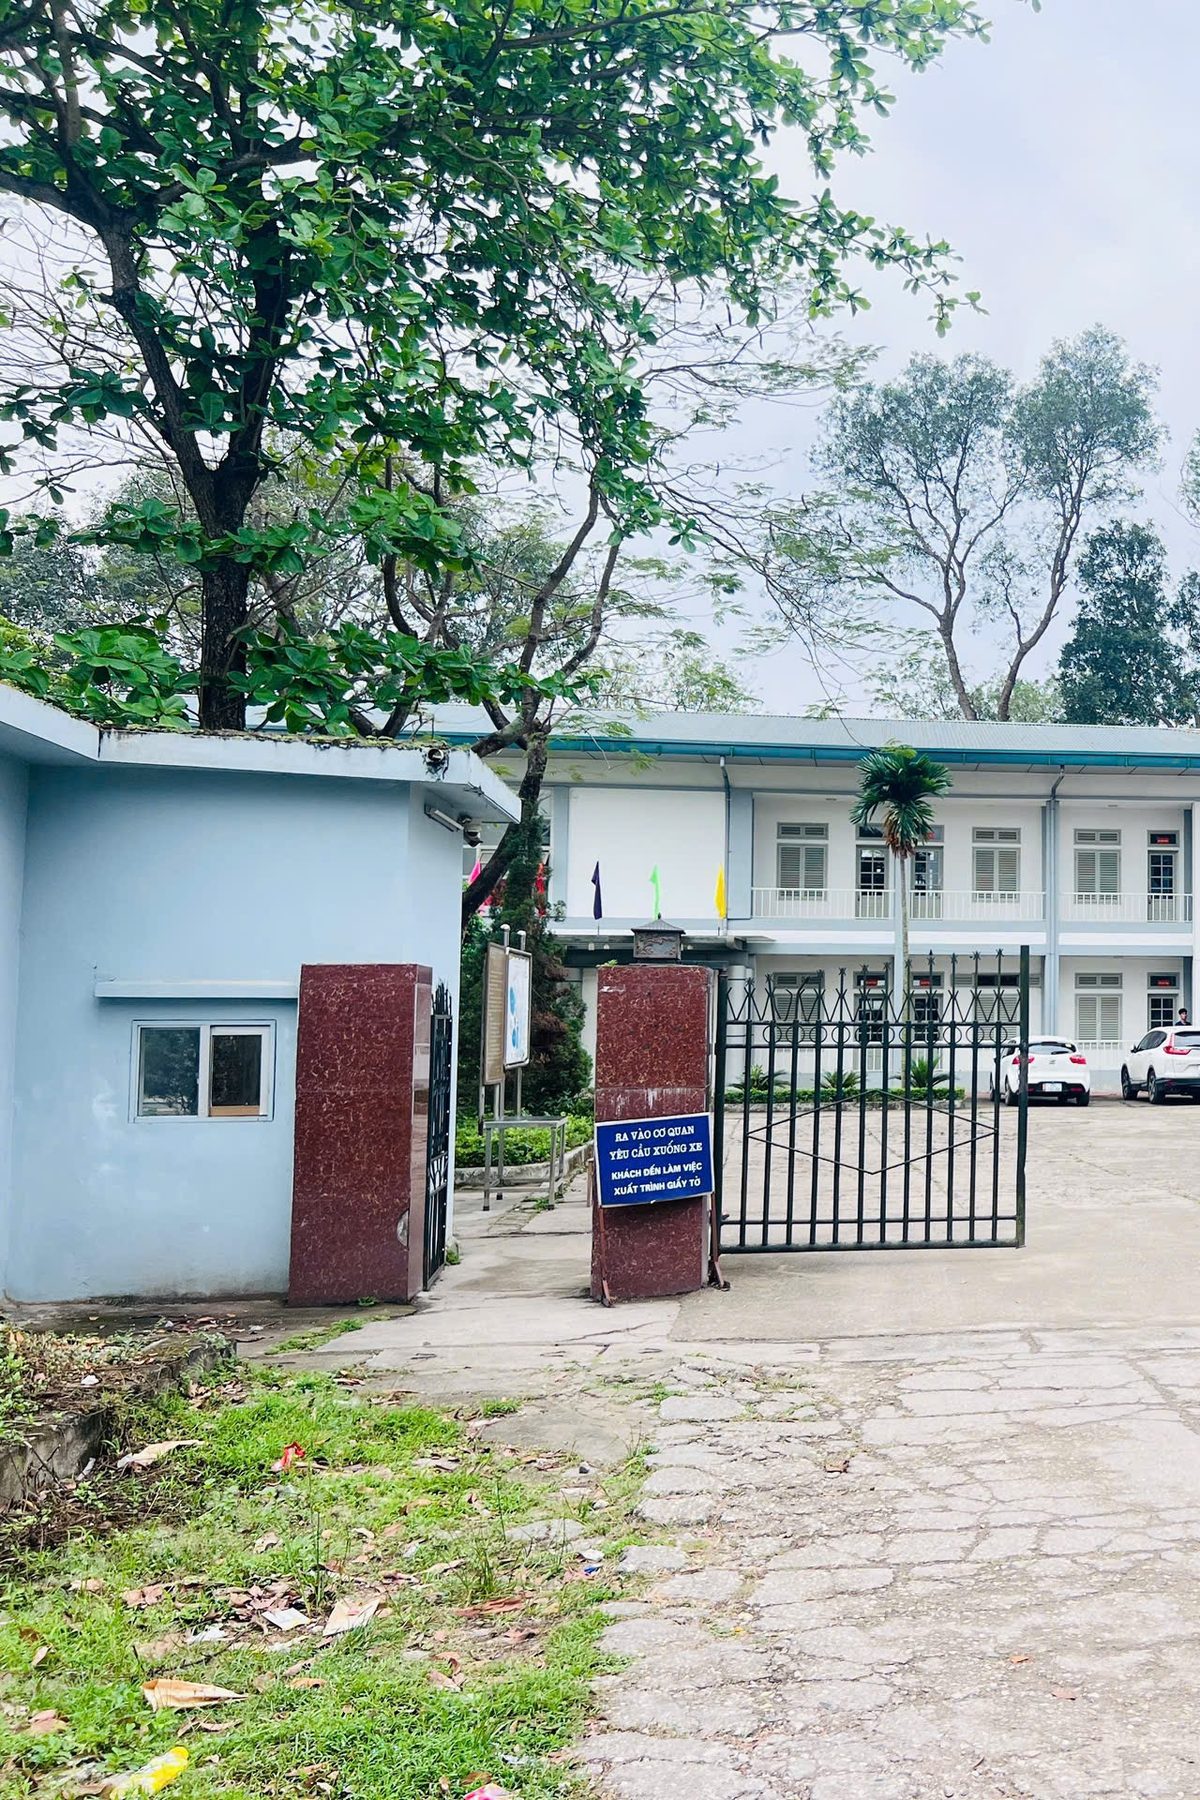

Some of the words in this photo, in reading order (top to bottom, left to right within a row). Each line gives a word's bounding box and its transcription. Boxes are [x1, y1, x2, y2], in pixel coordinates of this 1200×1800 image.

[615, 1132, 629, 1142] RA
[631, 1128, 651, 1141] VÀO
[653, 1127, 666, 1138] CƠ
[667, 1125, 695, 1137] QUAN
[609, 1148, 629, 1160] YÊU
[653, 1140, 687, 1156] XUỐNG
[689, 1142, 703, 1152] XE
[611, 1168, 642, 1180] KHÁCH
[643, 1164, 661, 1176] ĐẾN
[663, 1163, 681, 1174] LÀM
[683, 1161, 703, 1173] VIỆC
[614, 1182, 637, 1196] XUẤT
[640, 1181, 665, 1192] TRÌNH
[666, 1176, 687, 1189] GIẤY
